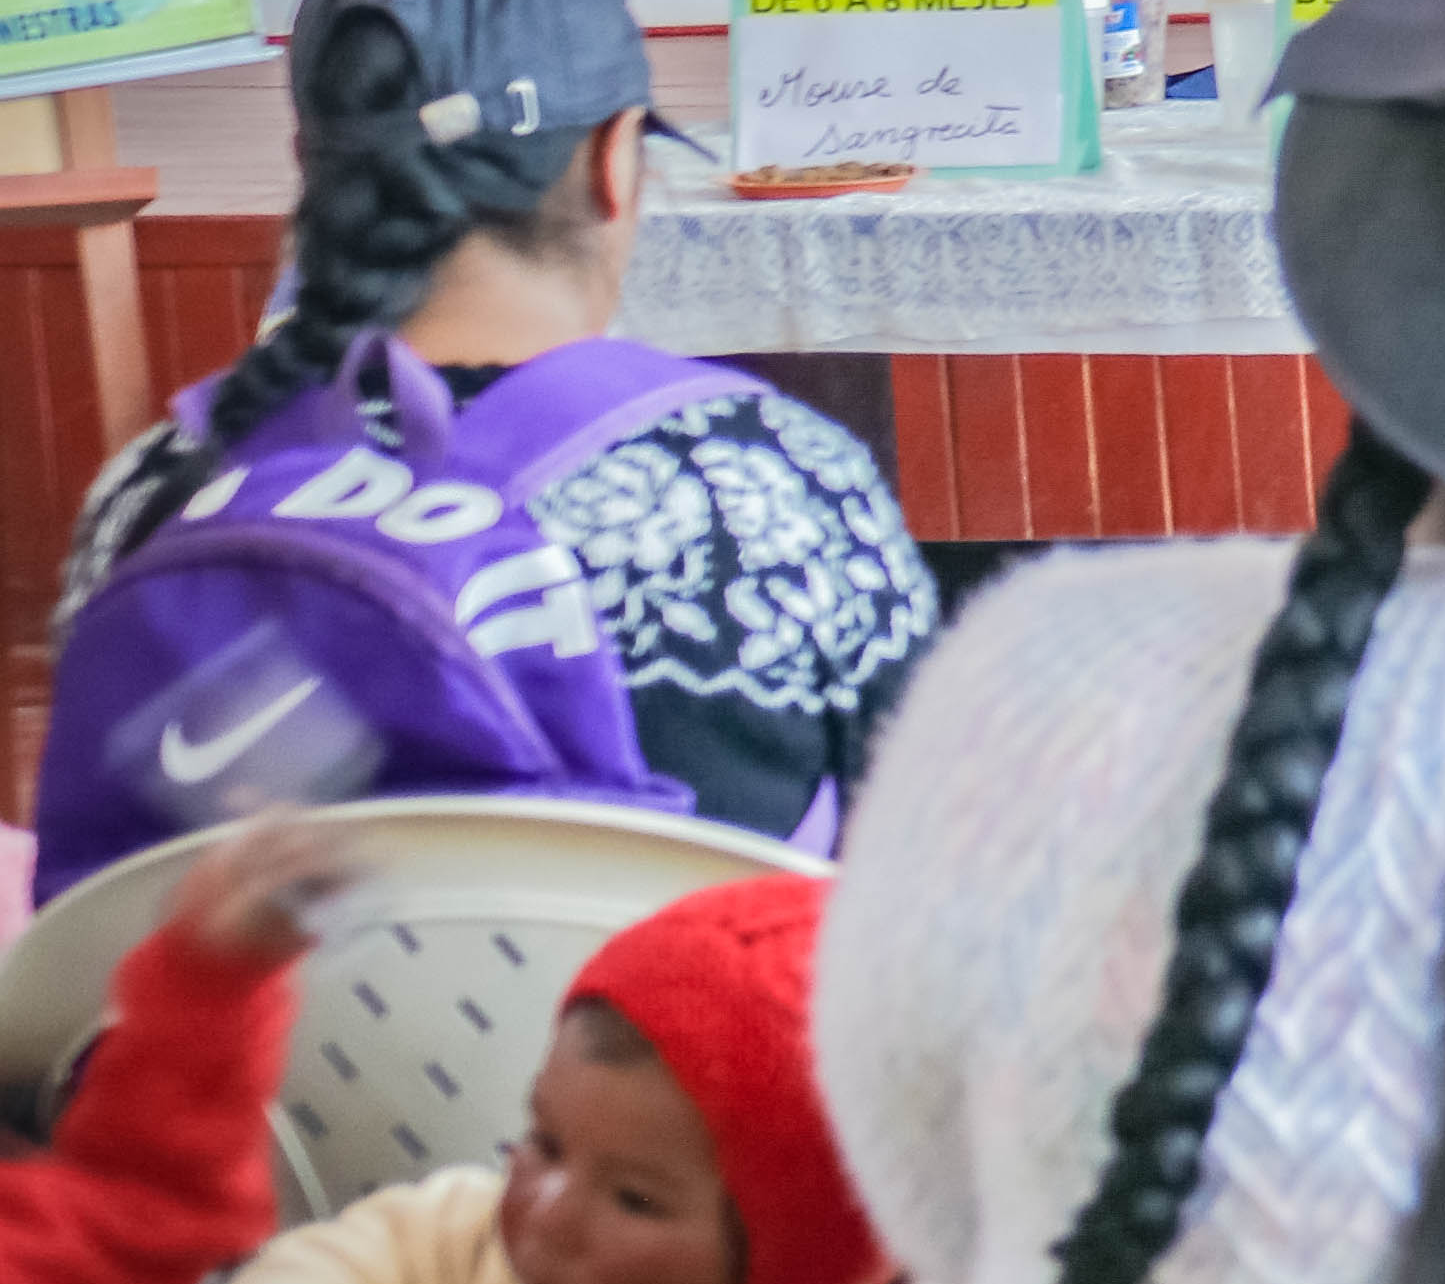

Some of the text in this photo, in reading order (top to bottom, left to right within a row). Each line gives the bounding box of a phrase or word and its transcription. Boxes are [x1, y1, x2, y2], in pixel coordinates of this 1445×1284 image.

[915, 65, 964, 96] de
[272, 446, 504, 544] DO
[455, 543, 600, 660] IT
